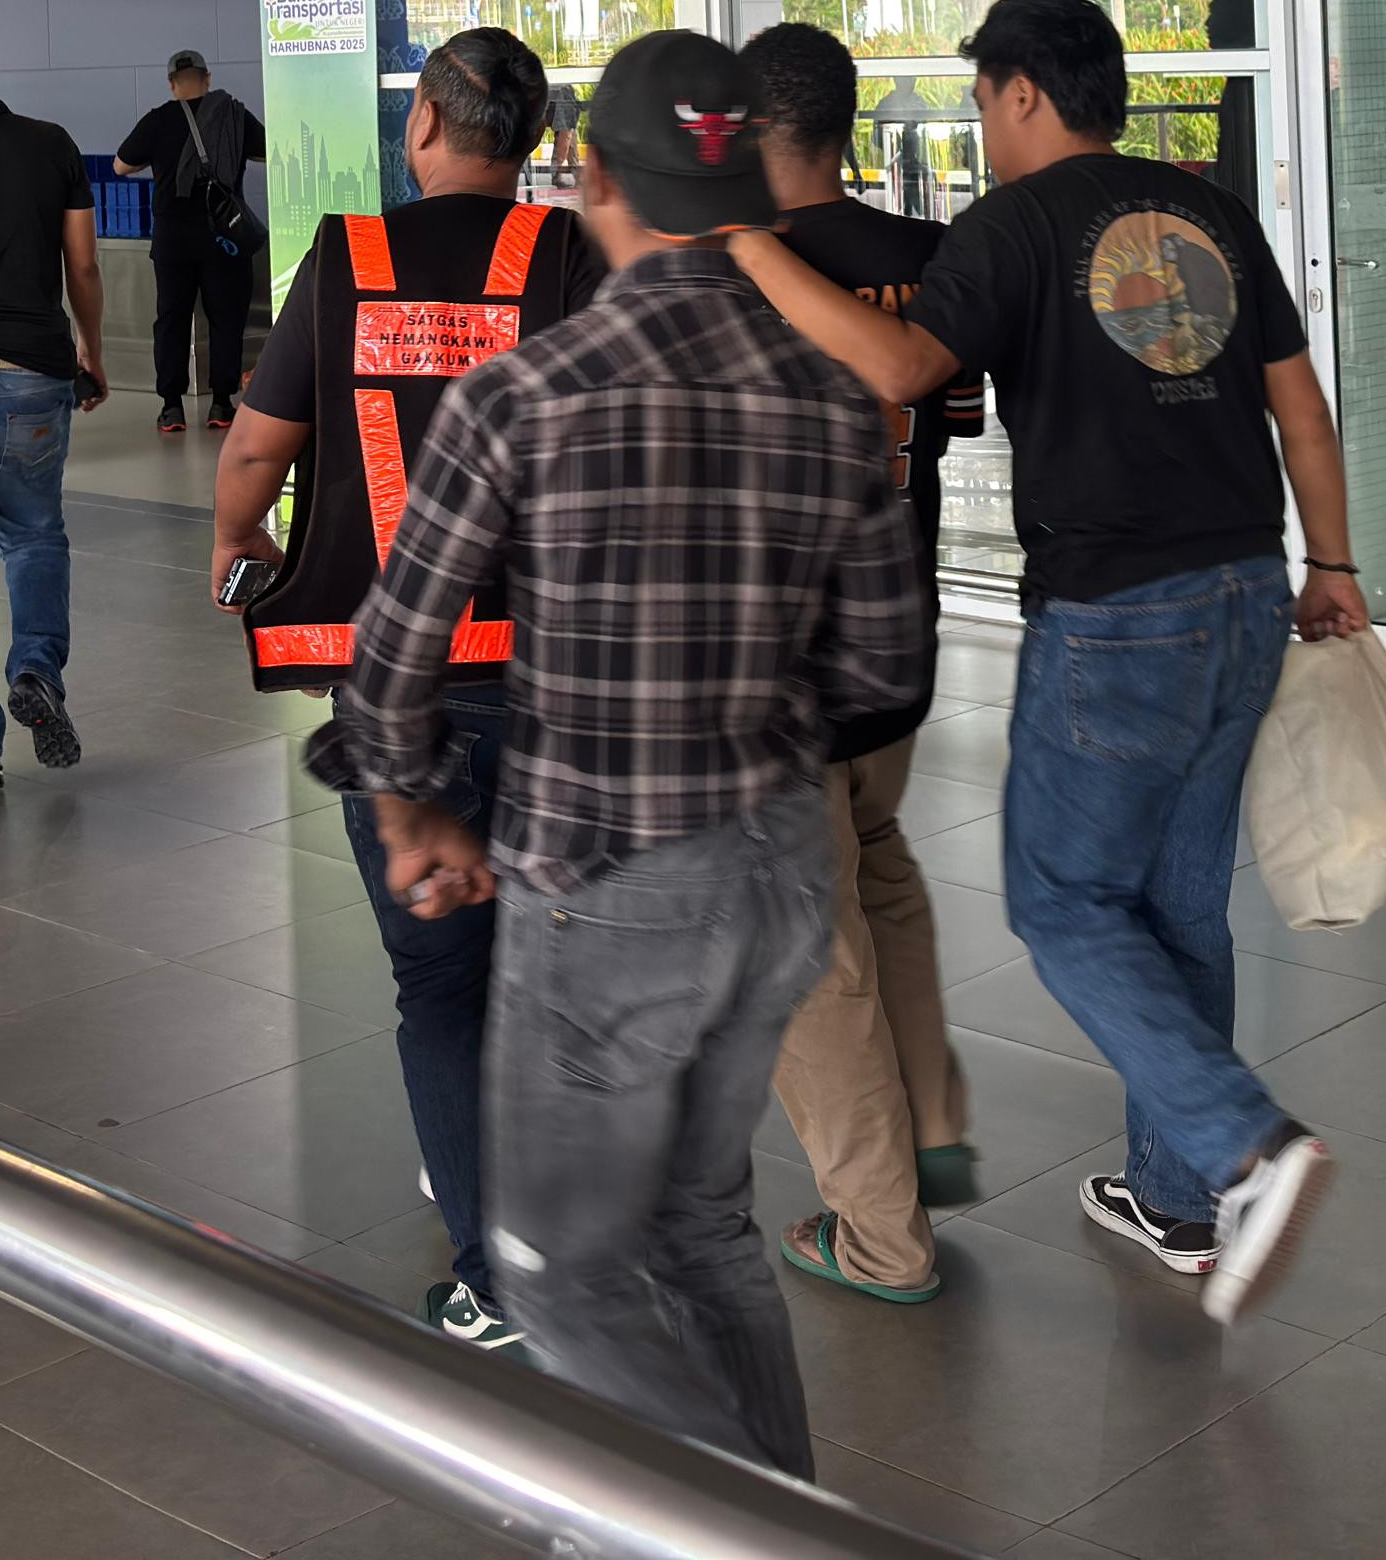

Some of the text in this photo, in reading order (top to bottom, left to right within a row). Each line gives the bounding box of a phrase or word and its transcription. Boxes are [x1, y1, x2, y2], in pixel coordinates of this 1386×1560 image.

[270, 39, 364, 54] HARHUBNAS 2025
[406, 313, 468, 329] SATGAS
[379, 332, 495, 349] NEMANGKAWI
[401, 352, 471, 368] GAKKUM
